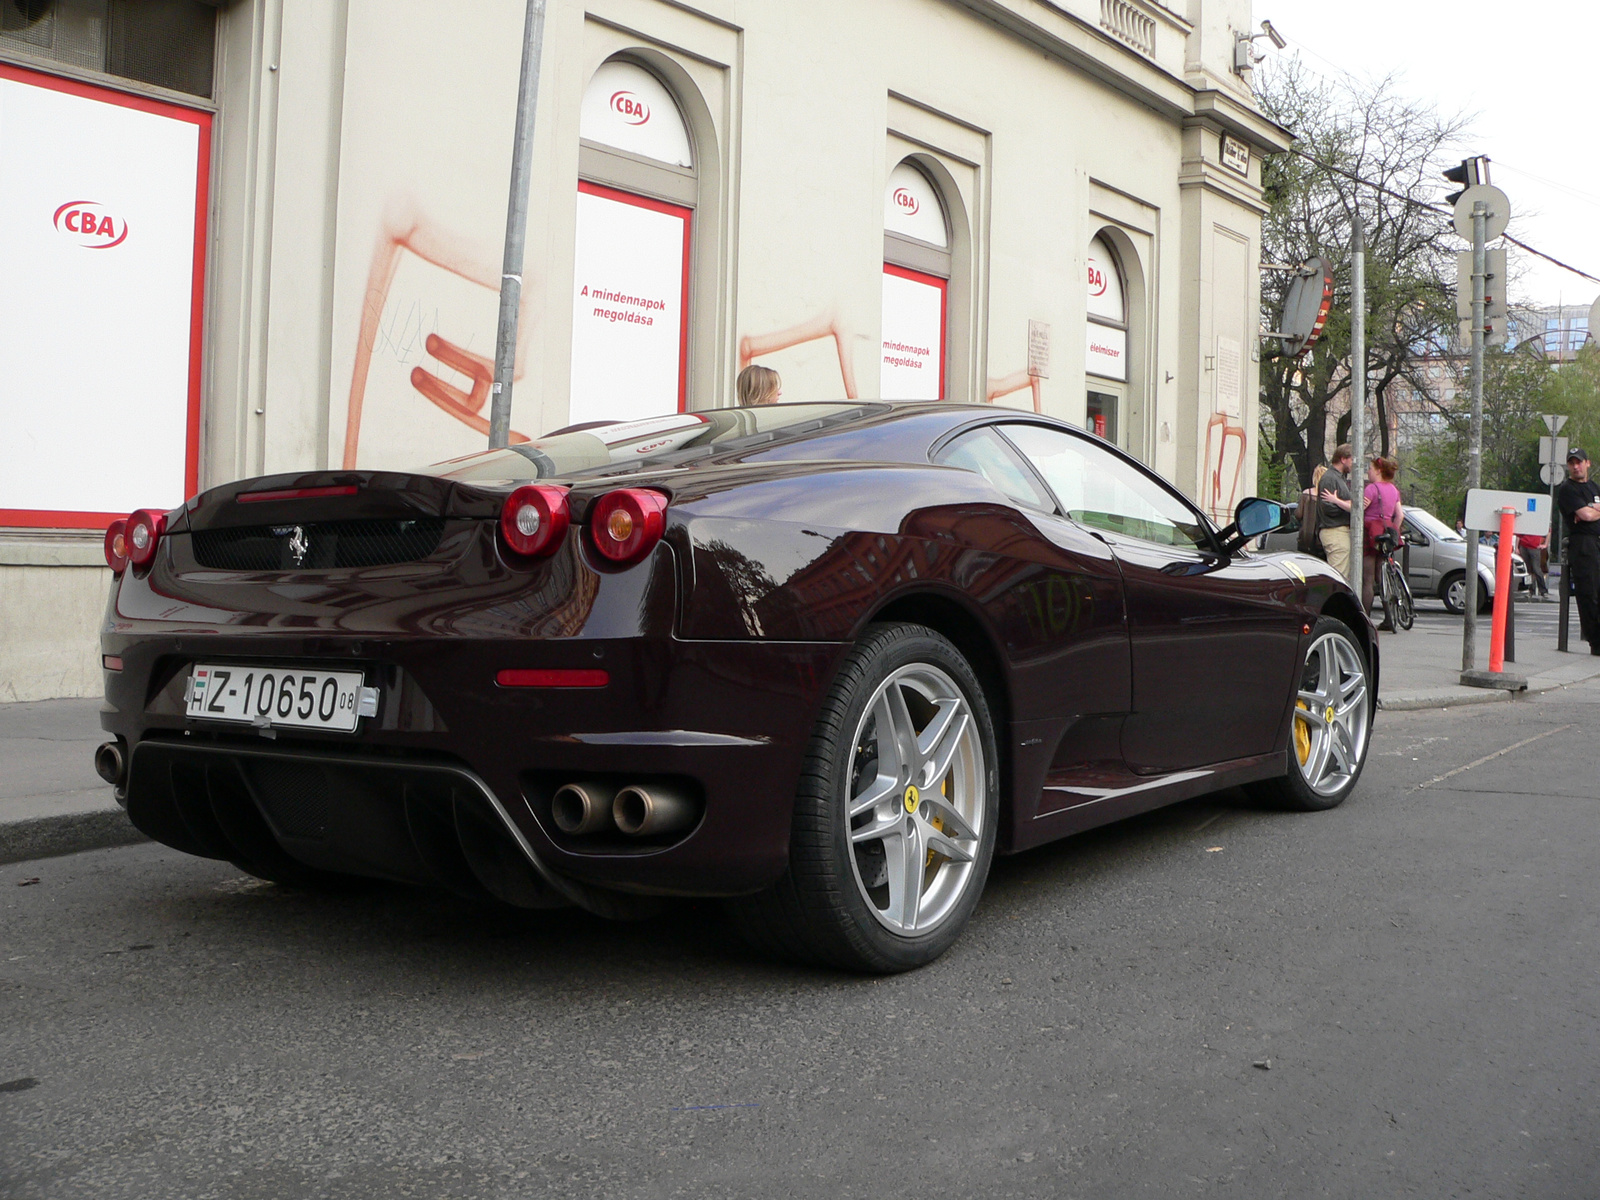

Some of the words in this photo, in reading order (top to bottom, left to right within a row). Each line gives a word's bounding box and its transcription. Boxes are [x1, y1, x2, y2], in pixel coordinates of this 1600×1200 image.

[616, 97, 643, 118] CBA
[897, 193, 915, 209] CBA
[65, 210, 115, 238] CBA
[1087, 267, 1102, 287] BA
[581, 285, 588, 296] A
[592, 288, 666, 311] mindennapok
[593, 307, 654, 326] megoldása
[882, 340, 930, 356] mindennapok
[1090, 342, 1120, 358] élelmiszer
[883, 355, 922, 369] megoldása
[191, 691, 204, 711] H
[207, 671, 339, 722] Z-10650
[340, 692, 354, 710] 08
